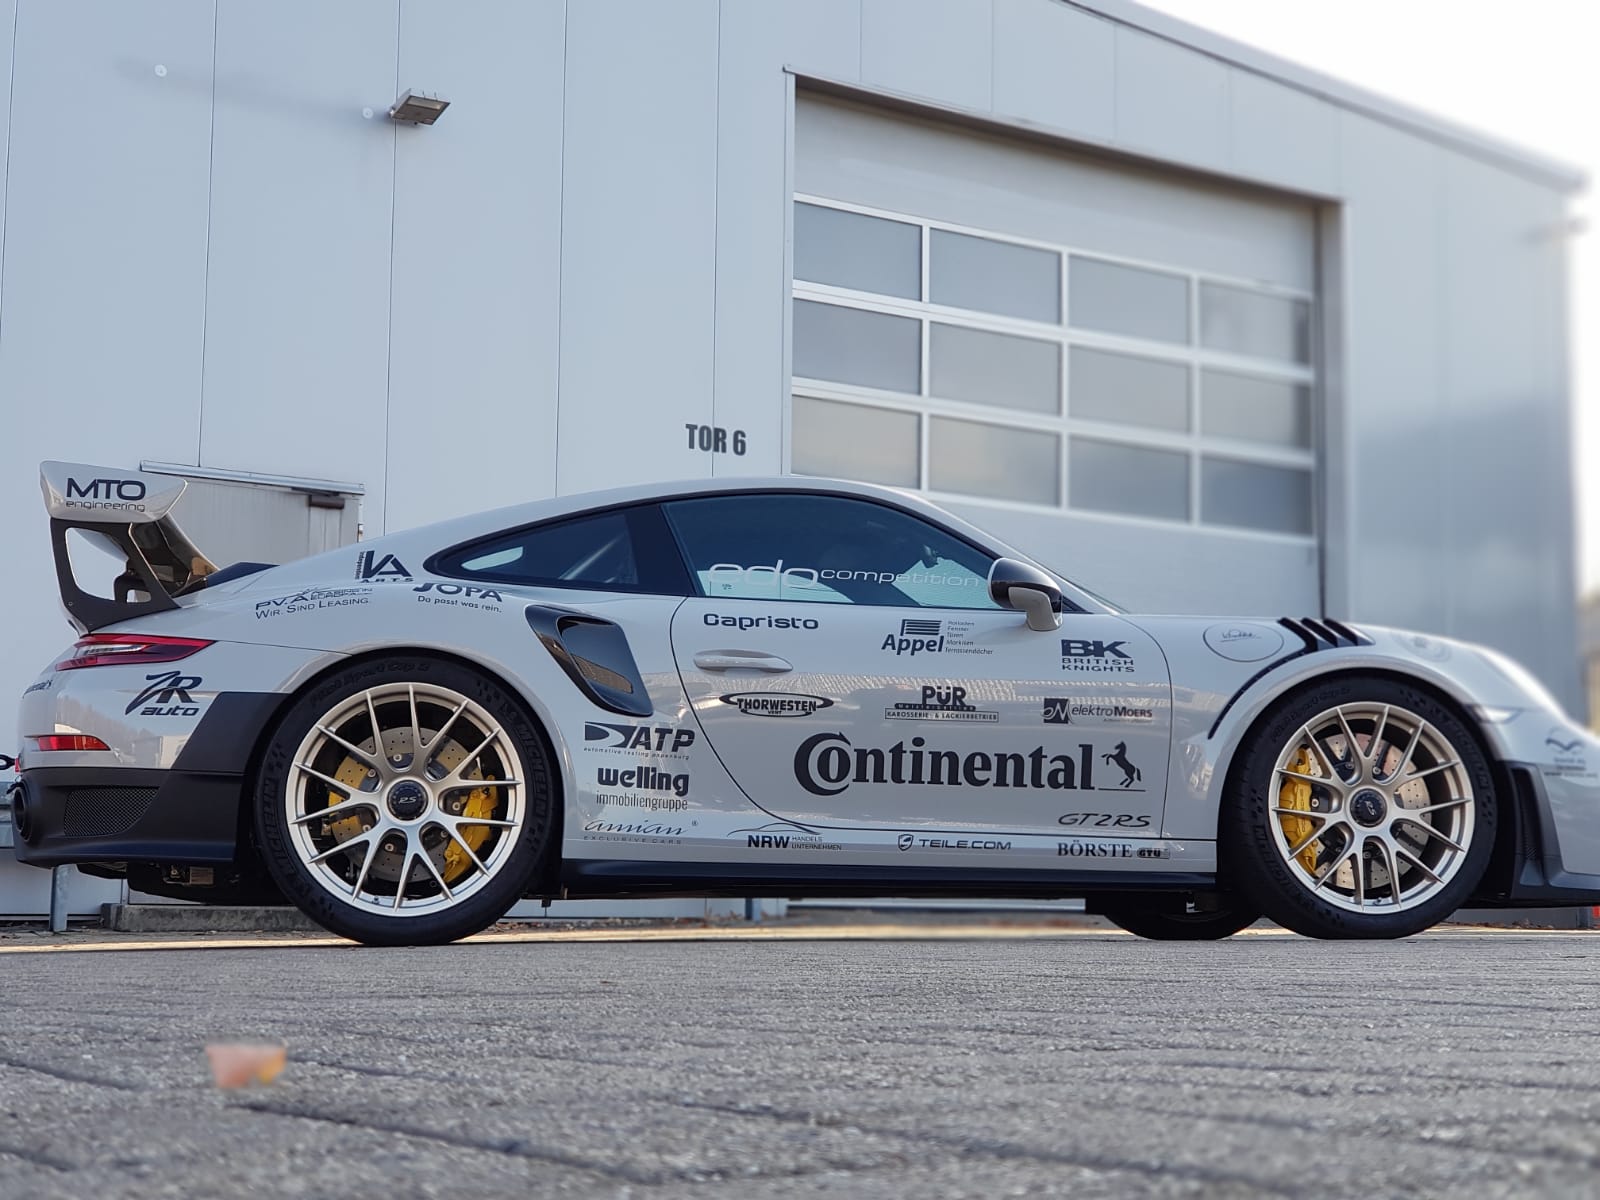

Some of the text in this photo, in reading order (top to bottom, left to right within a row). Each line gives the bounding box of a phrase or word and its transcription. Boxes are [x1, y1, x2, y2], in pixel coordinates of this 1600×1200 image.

[685, 423, 746, 456] TOR 6
[66, 477, 146, 501] MTO
[65, 500, 146, 513] engineering
[709, 559, 979, 588] edo competition
[412, 582, 503, 603] JOPA
[417, 594, 503, 613] Da passt was rein.
[703, 613, 819, 631] Capristo
[881, 633, 945, 656] Appel
[1061, 639, 1132, 659] BK
[1061, 657, 1134, 666] BRITISH
[1061, 664, 1135, 673] KNIGHTS
[140, 705, 200, 717] auto
[737, 697, 817, 712] THORWESTEN
[629, 726, 696, 752] ATP
[793, 731, 1096, 797] Continental
[597, 766, 690, 797] welling
[596, 790, 689, 812] immobiliengruppe
[584, 819, 688, 836] amian
[747, 834, 791, 849] NRW
[791, 843, 842, 851] UNTERNEHMEN
[918, 838, 1012, 850] TEILE.COM
[1057, 840, 1133, 858] BÖRSTE
